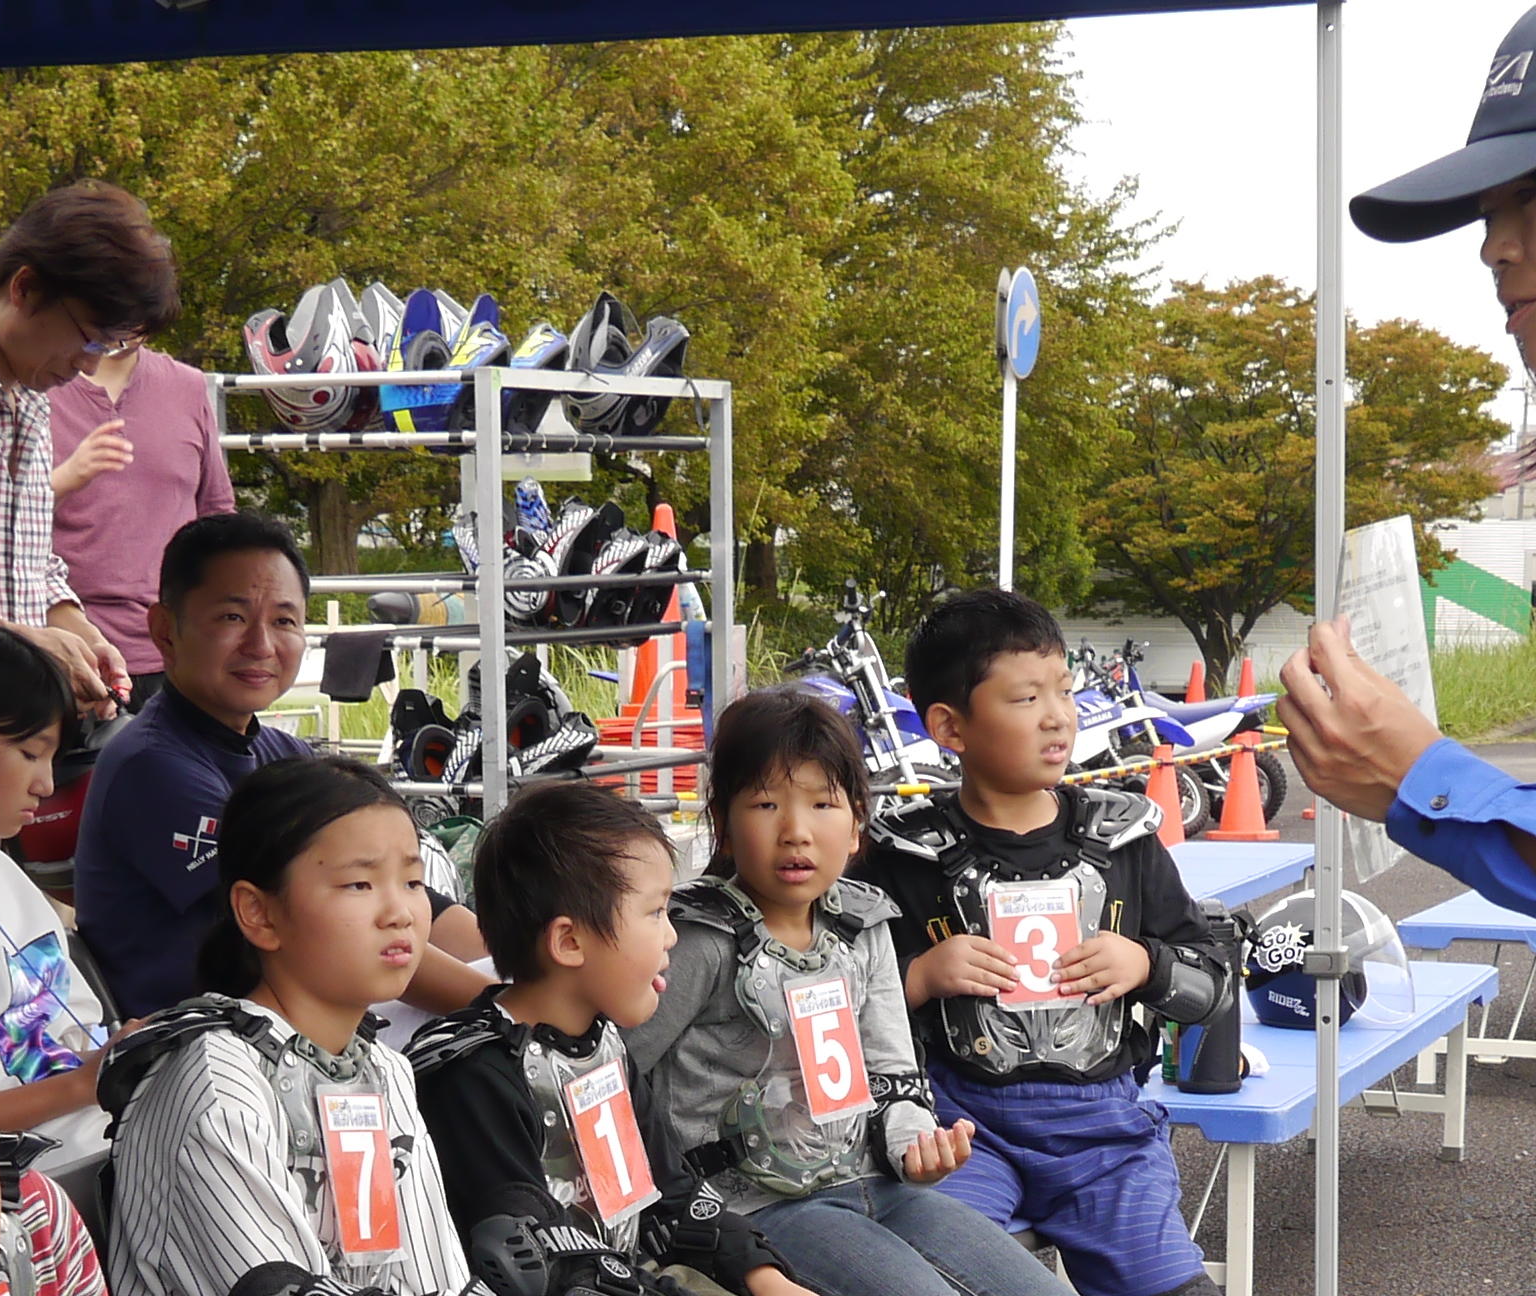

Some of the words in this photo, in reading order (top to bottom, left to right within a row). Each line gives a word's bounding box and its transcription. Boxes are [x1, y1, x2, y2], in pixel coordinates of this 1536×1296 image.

[1014, 915, 1062, 993] 3
[1263, 932, 1293, 949] GO!
[1268, 946, 1302, 964] GO!
[811, 1011, 852, 1101] 5
[979, 1041, 987, 1051] S
[339, 1131, 375, 1239] 7
[594, 1101, 633, 1196] 1
